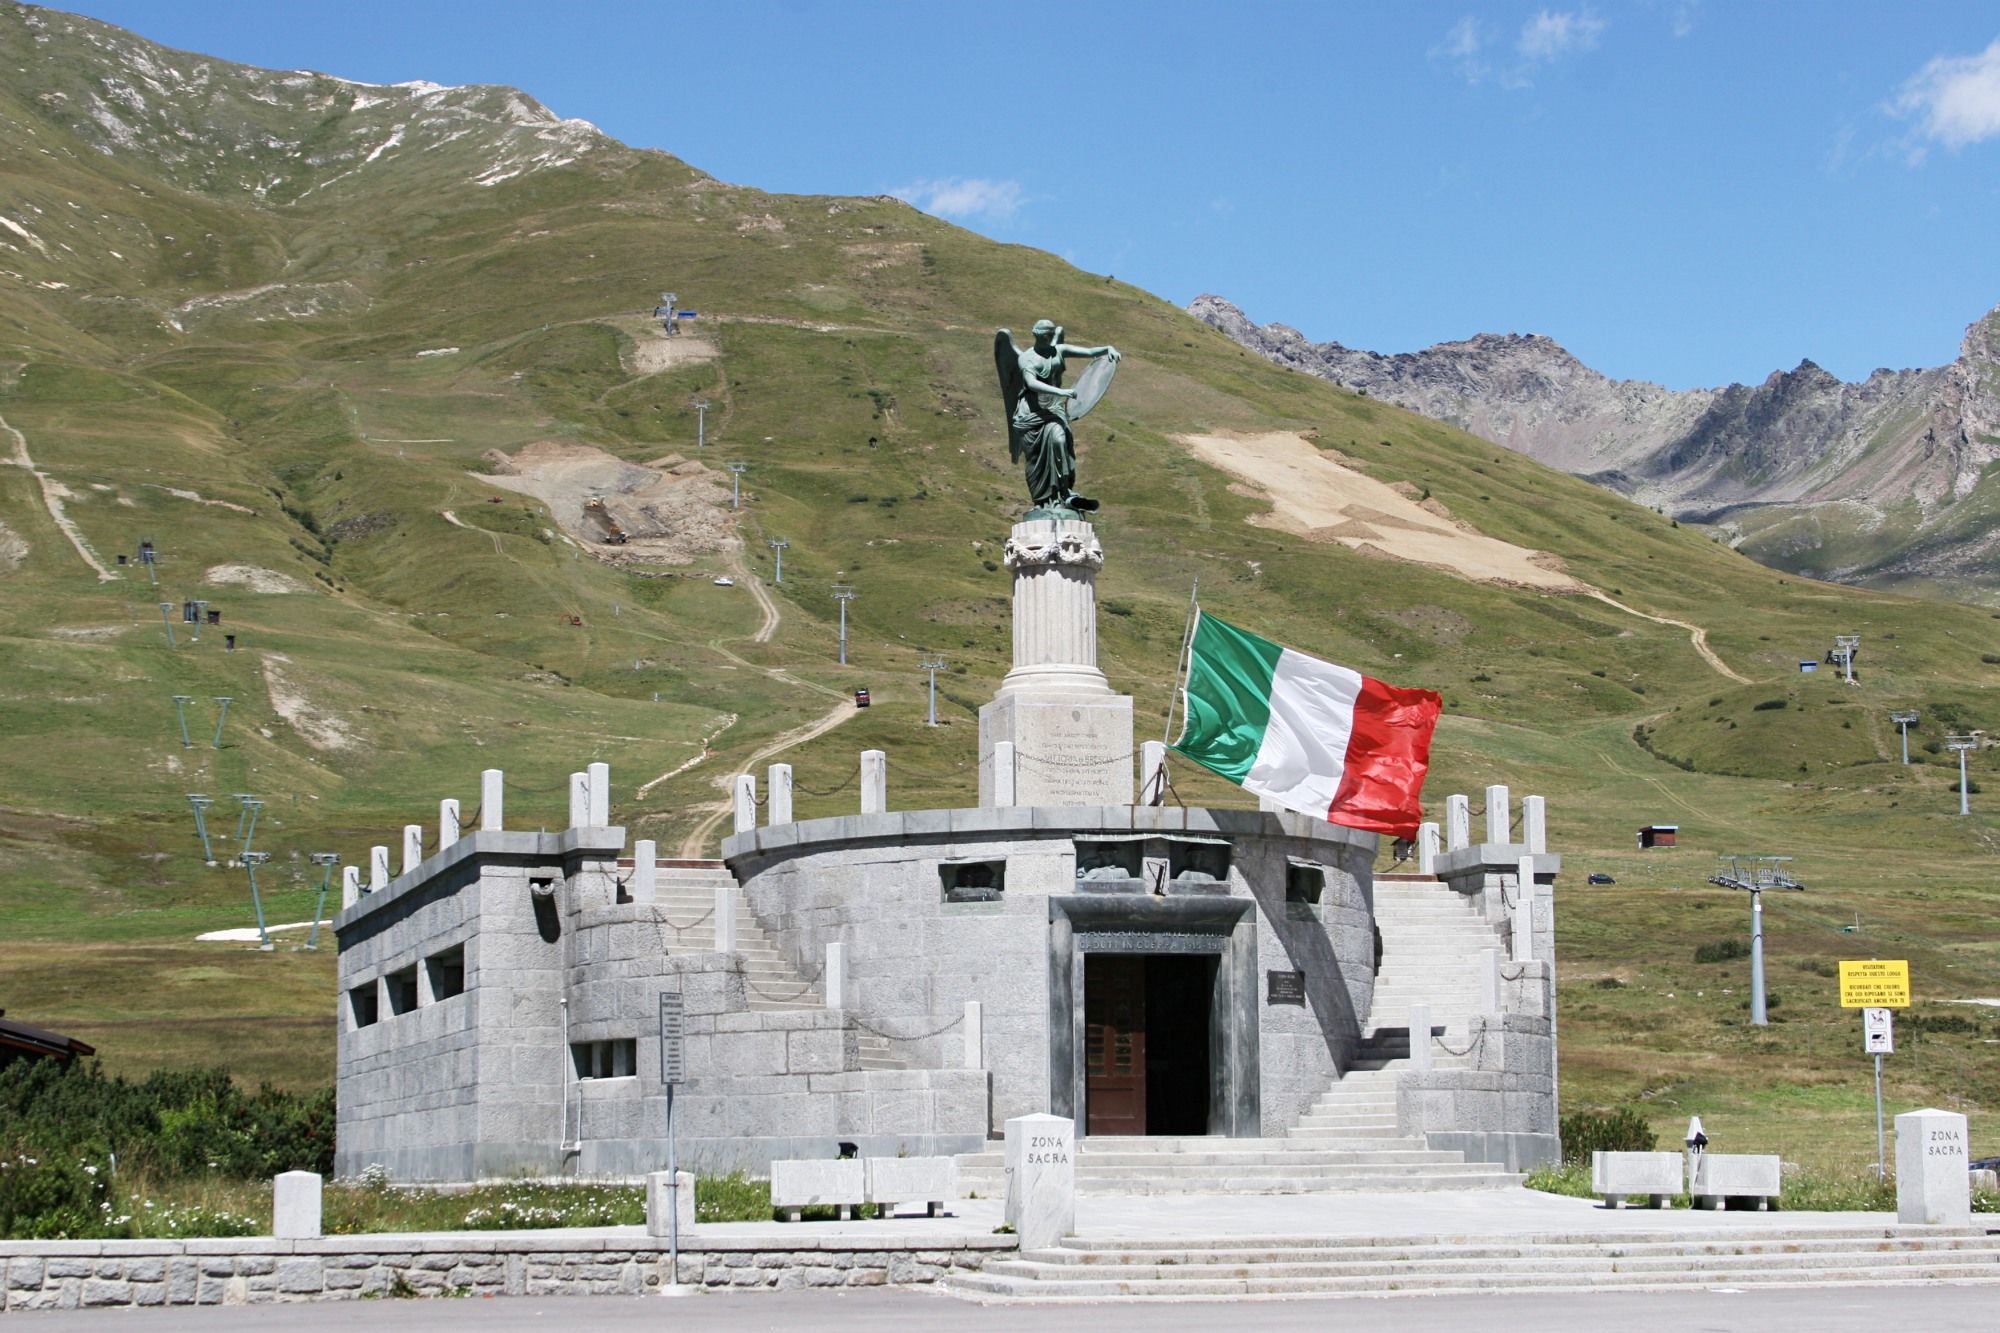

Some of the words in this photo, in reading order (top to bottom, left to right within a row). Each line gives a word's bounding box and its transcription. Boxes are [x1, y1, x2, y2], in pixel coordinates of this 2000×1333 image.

[1931, 1131, 1960, 1141] ZONA
[1031, 1136, 1063, 1147] ZONA
[1928, 1146, 1963, 1156] SACRA
[1028, 1152, 1069, 1164] SACRA
